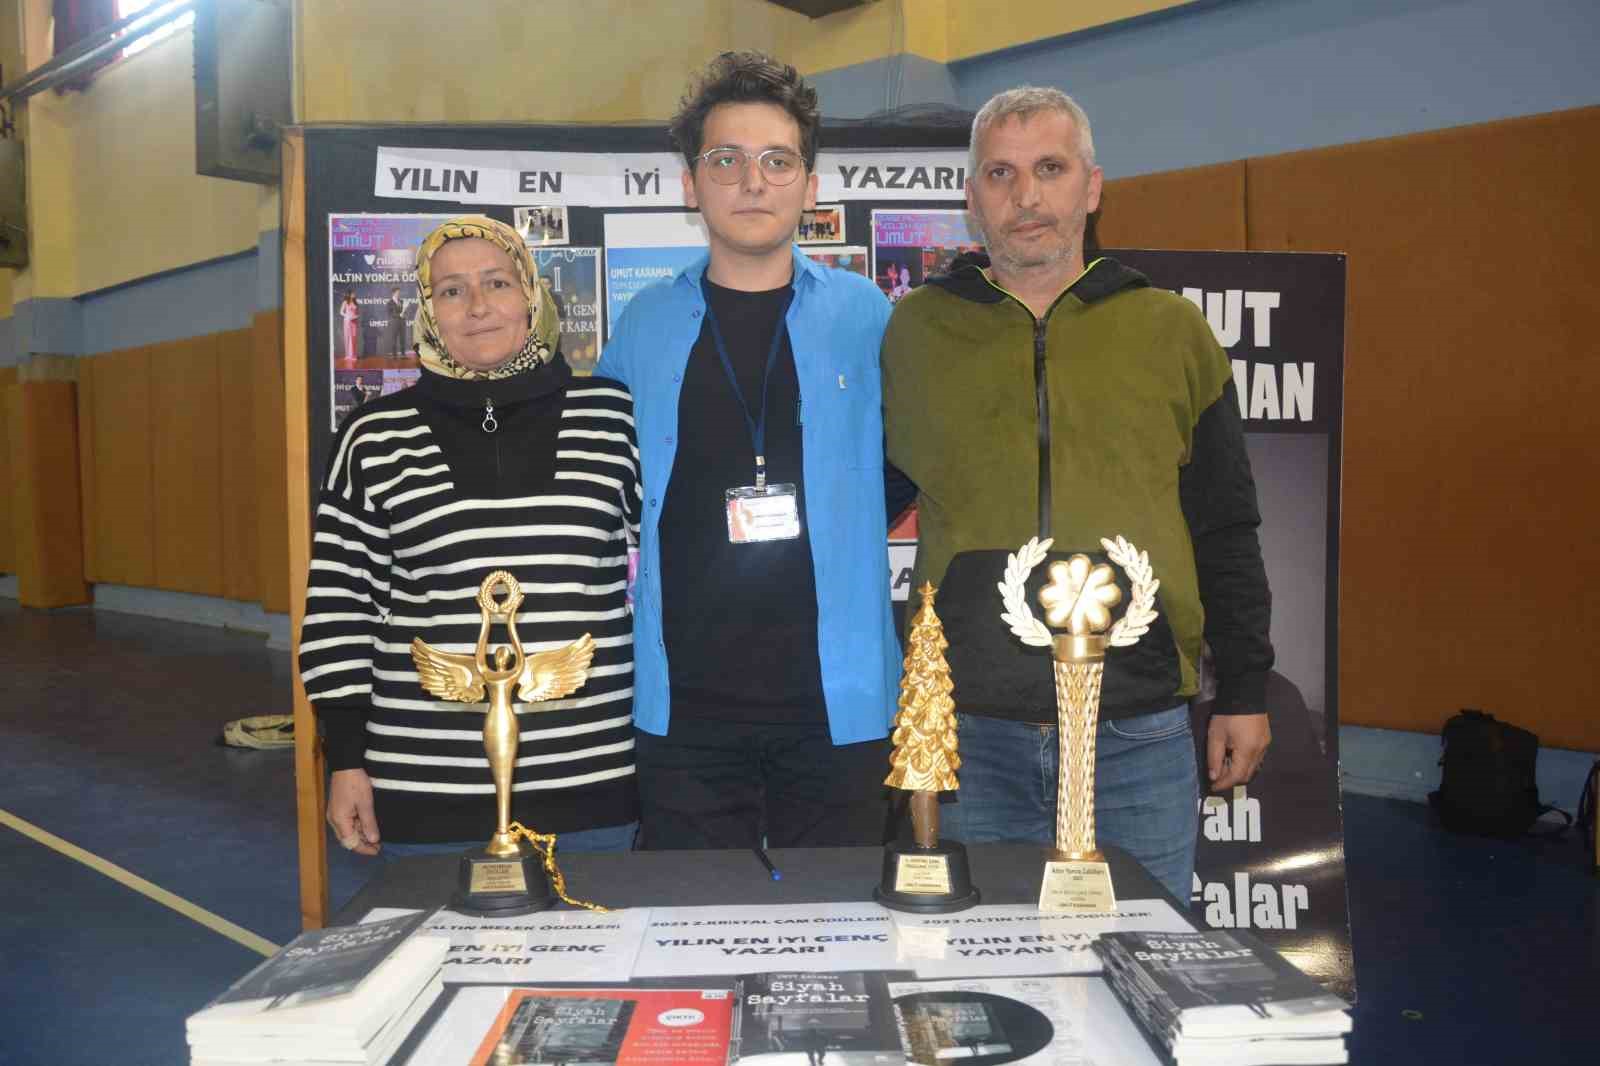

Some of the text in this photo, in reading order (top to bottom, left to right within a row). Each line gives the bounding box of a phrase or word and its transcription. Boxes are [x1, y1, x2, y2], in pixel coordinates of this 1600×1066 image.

[389, 167, 478, 194] YILIN
[518, 171, 562, 194] EN
[837, 166, 965, 190] YAZARI
[332, 272, 362, 282] ALTIN
[572, 303, 598, 316] GEN
[1182, 286, 1281, 348] UT
[566, 321, 598, 333] KARA
[1198, 784, 1262, 842] ah
[964, 916, 1013, 924] ALTIN
[655, 936, 725, 947] YILIN
[732, 935, 769, 945] EN
[814, 933, 889, 943] GENÇ
[945, 935, 1012, 946] YILIN
[1019, 933, 1055, 944] EN
[448, 944, 487, 952] EN
[529, 944, 607, 954] GENÇ
[721, 945, 825, 955] YAZARI
[957, 945, 1055, 957] YAPAN
[1134, 948, 1254, 962] Sayfalar
[442, 956, 533, 965] AZARI
[770, 981, 846, 993] Siyah
[747, 993, 871, 1006] Sayfalar
